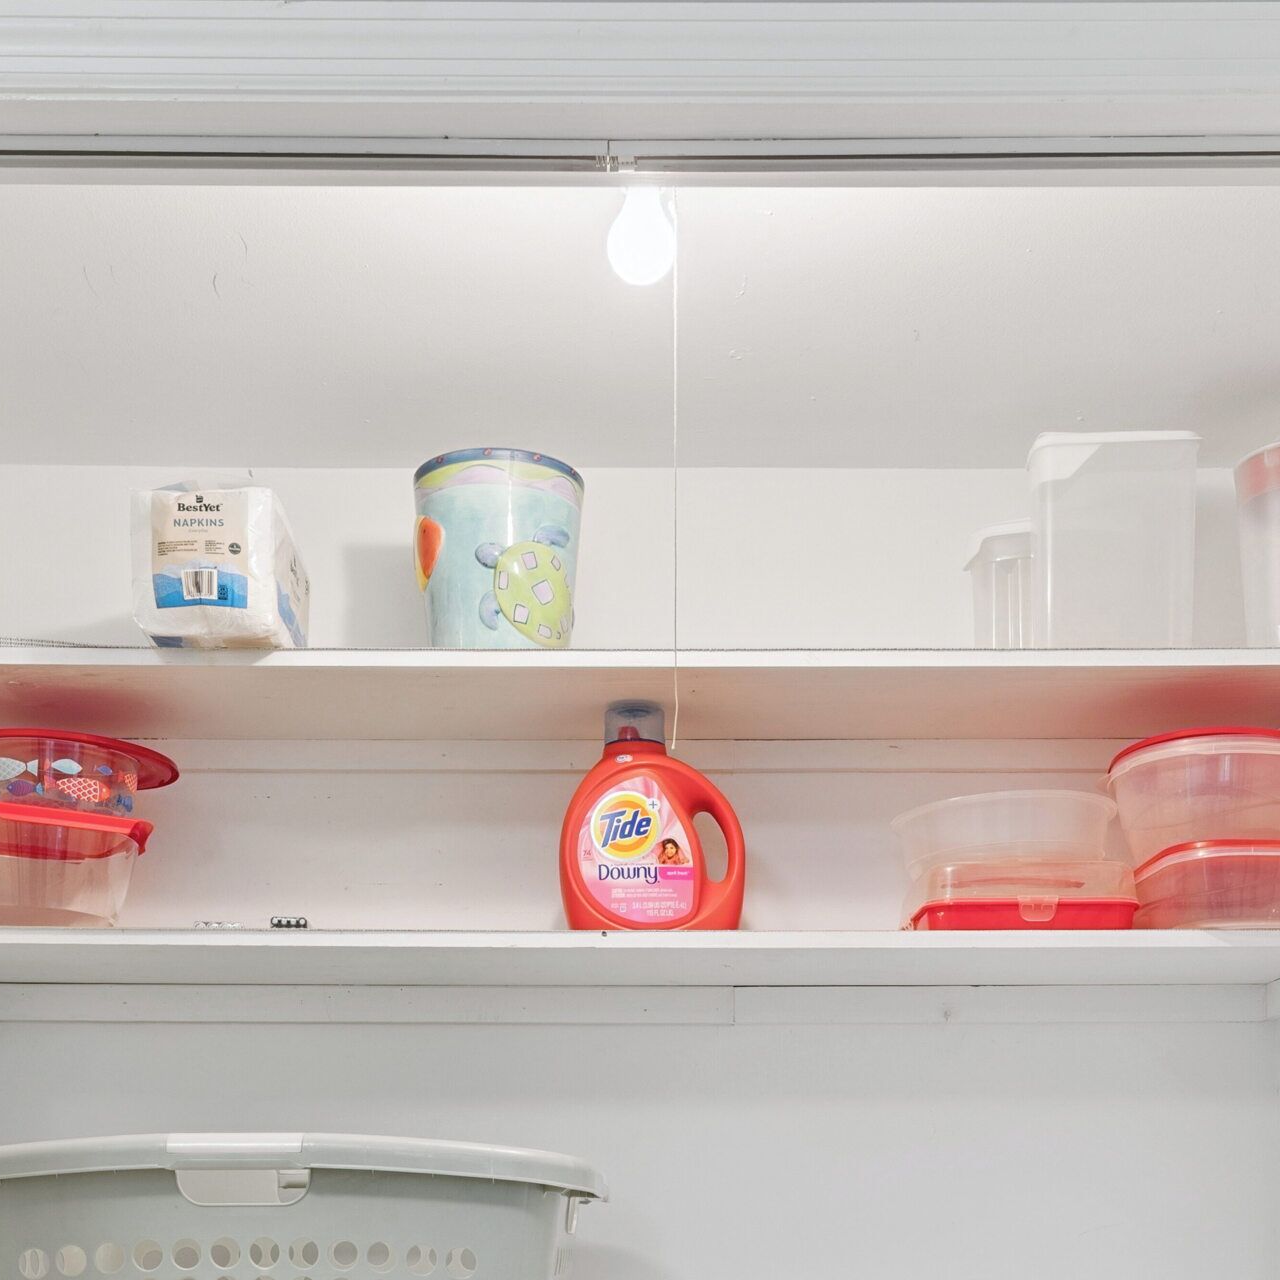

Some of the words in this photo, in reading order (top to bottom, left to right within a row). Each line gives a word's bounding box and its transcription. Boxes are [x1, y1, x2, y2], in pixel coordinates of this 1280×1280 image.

[177, 502, 221, 512] BestYet
[173, 518, 224, 527] NAPKINS
[599, 809, 652, 848] Tide
[598, 864, 659, 884] Downy
